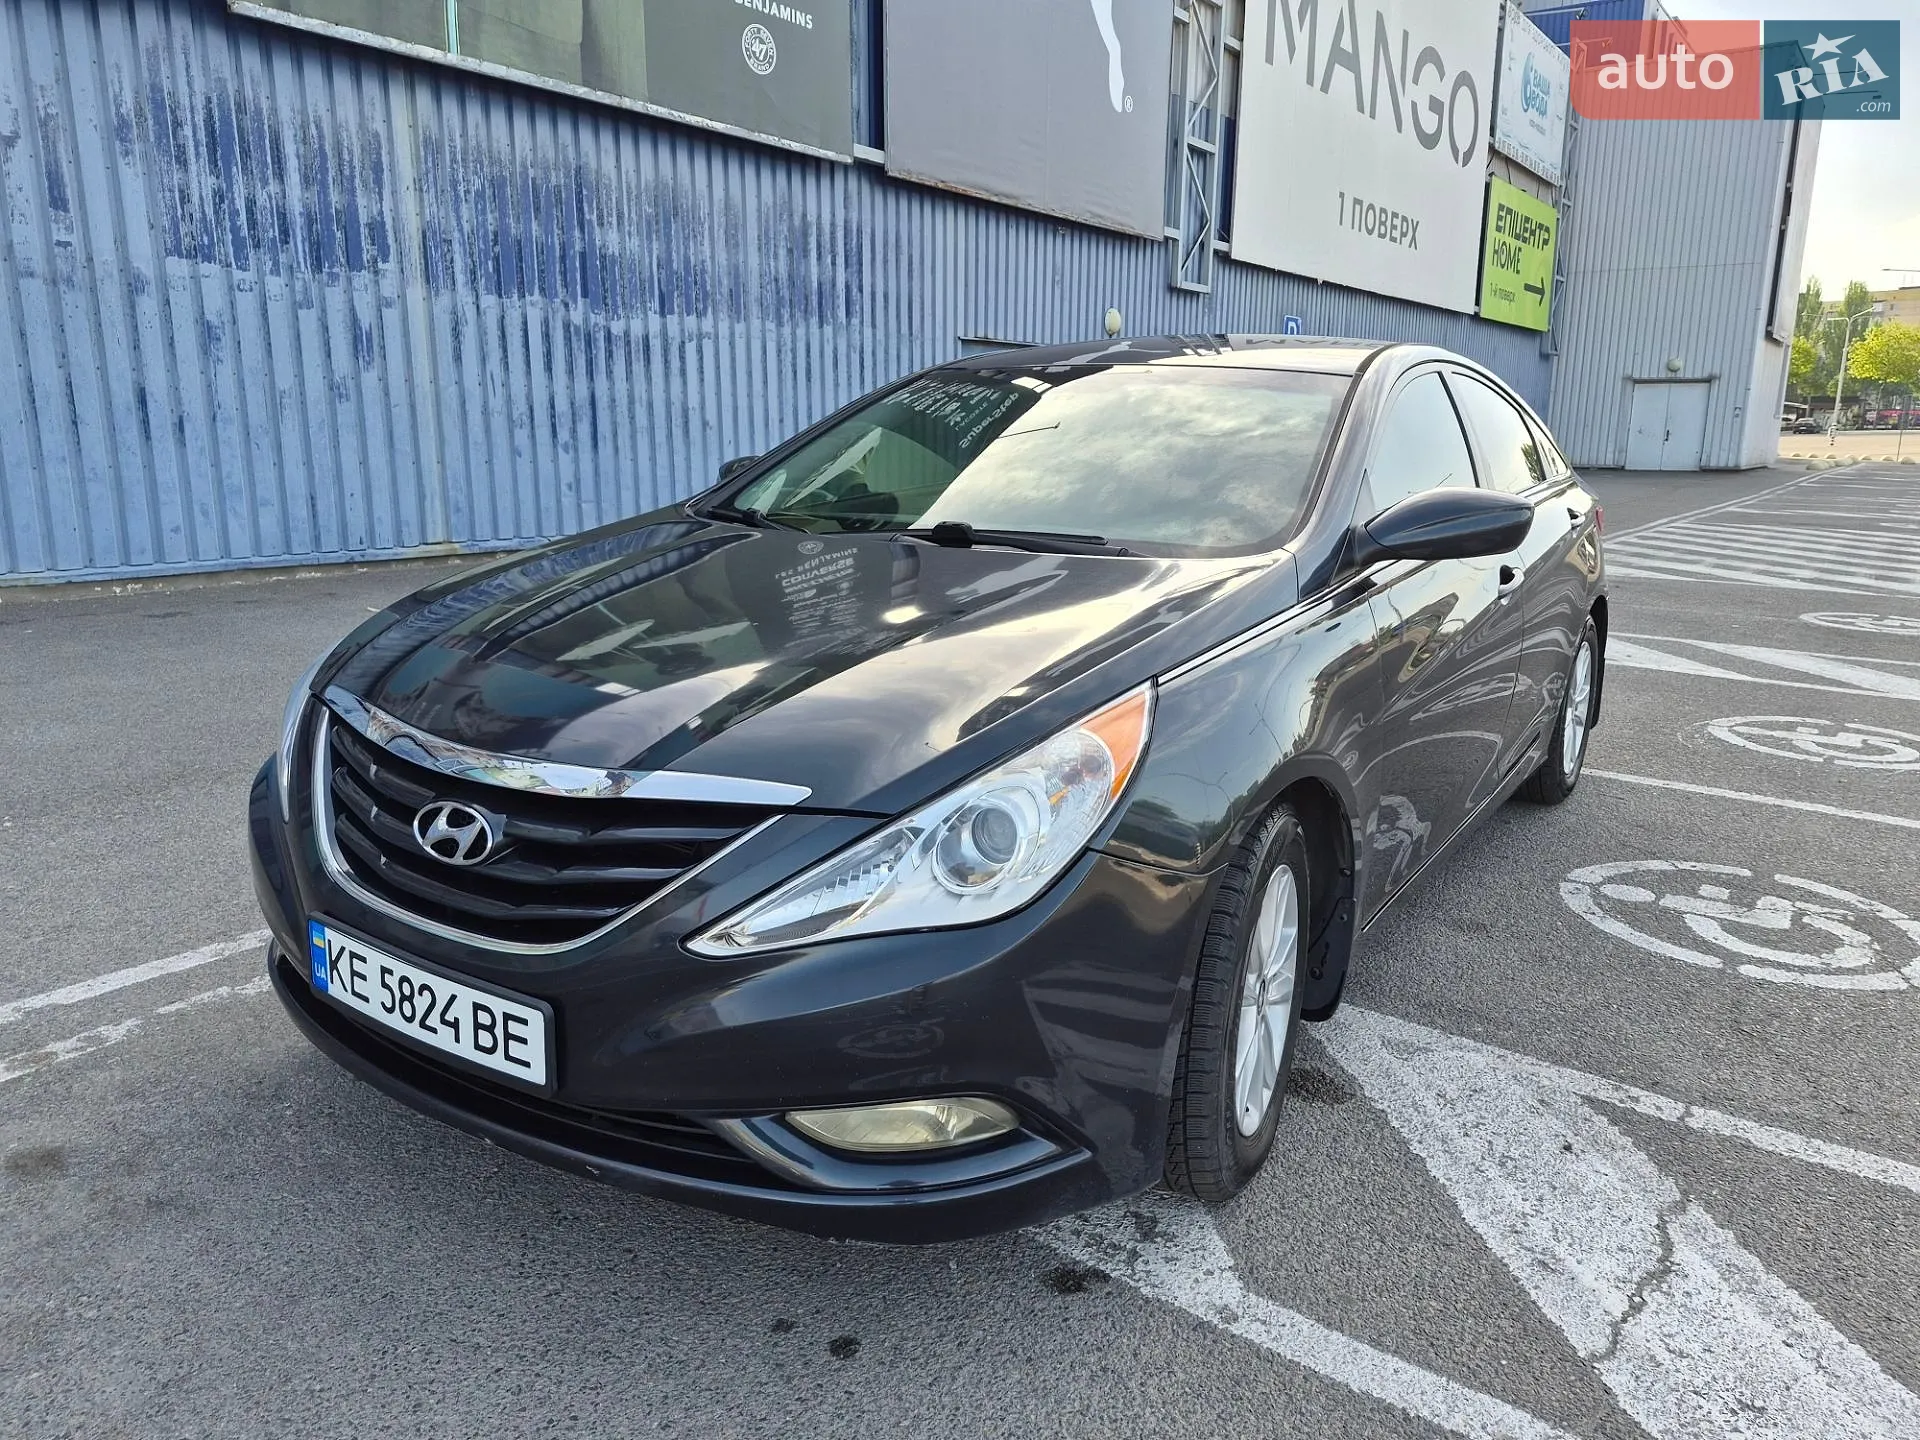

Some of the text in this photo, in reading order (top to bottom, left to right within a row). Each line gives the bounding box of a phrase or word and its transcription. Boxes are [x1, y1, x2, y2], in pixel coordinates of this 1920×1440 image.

[735, 0, 813, 29] ENJAMINS
[1265, 0, 1479, 168] MANGO
[1338, 191, 1419, 250] 1 ПОВЕРХ
[1496, 202, 1551, 251] ЕПІЦЕНТР
[1492, 237, 1522, 275] HOME
[315, 966, 327, 980] UA
[328, 939, 532, 1068] KE 5824 BE
